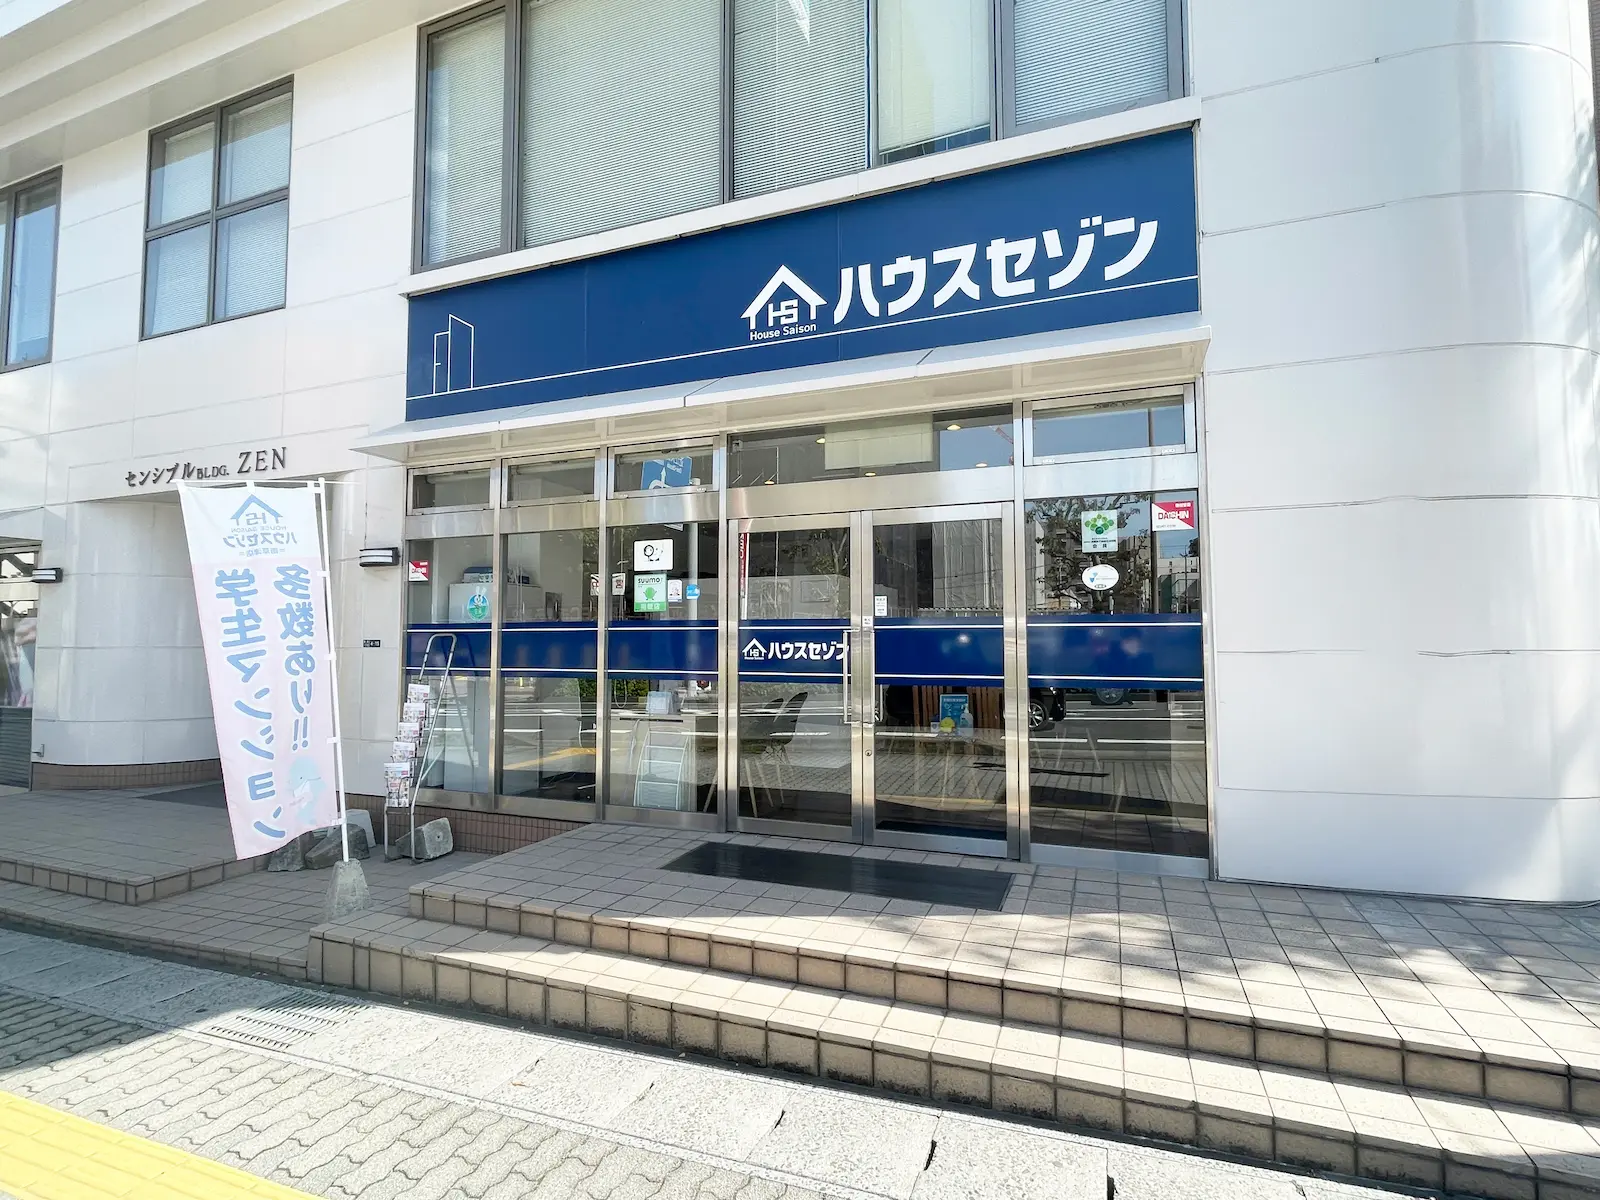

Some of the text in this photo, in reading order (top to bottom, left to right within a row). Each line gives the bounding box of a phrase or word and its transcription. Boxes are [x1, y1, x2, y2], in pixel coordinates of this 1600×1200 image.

[833, 215, 1159, 325] ハウスセゾン
[768, 299, 799, 327] HS
[749, 323, 817, 341] House Saison
[196, 464, 231, 480] BLDG.
[237, 446, 288, 475] ZEN
